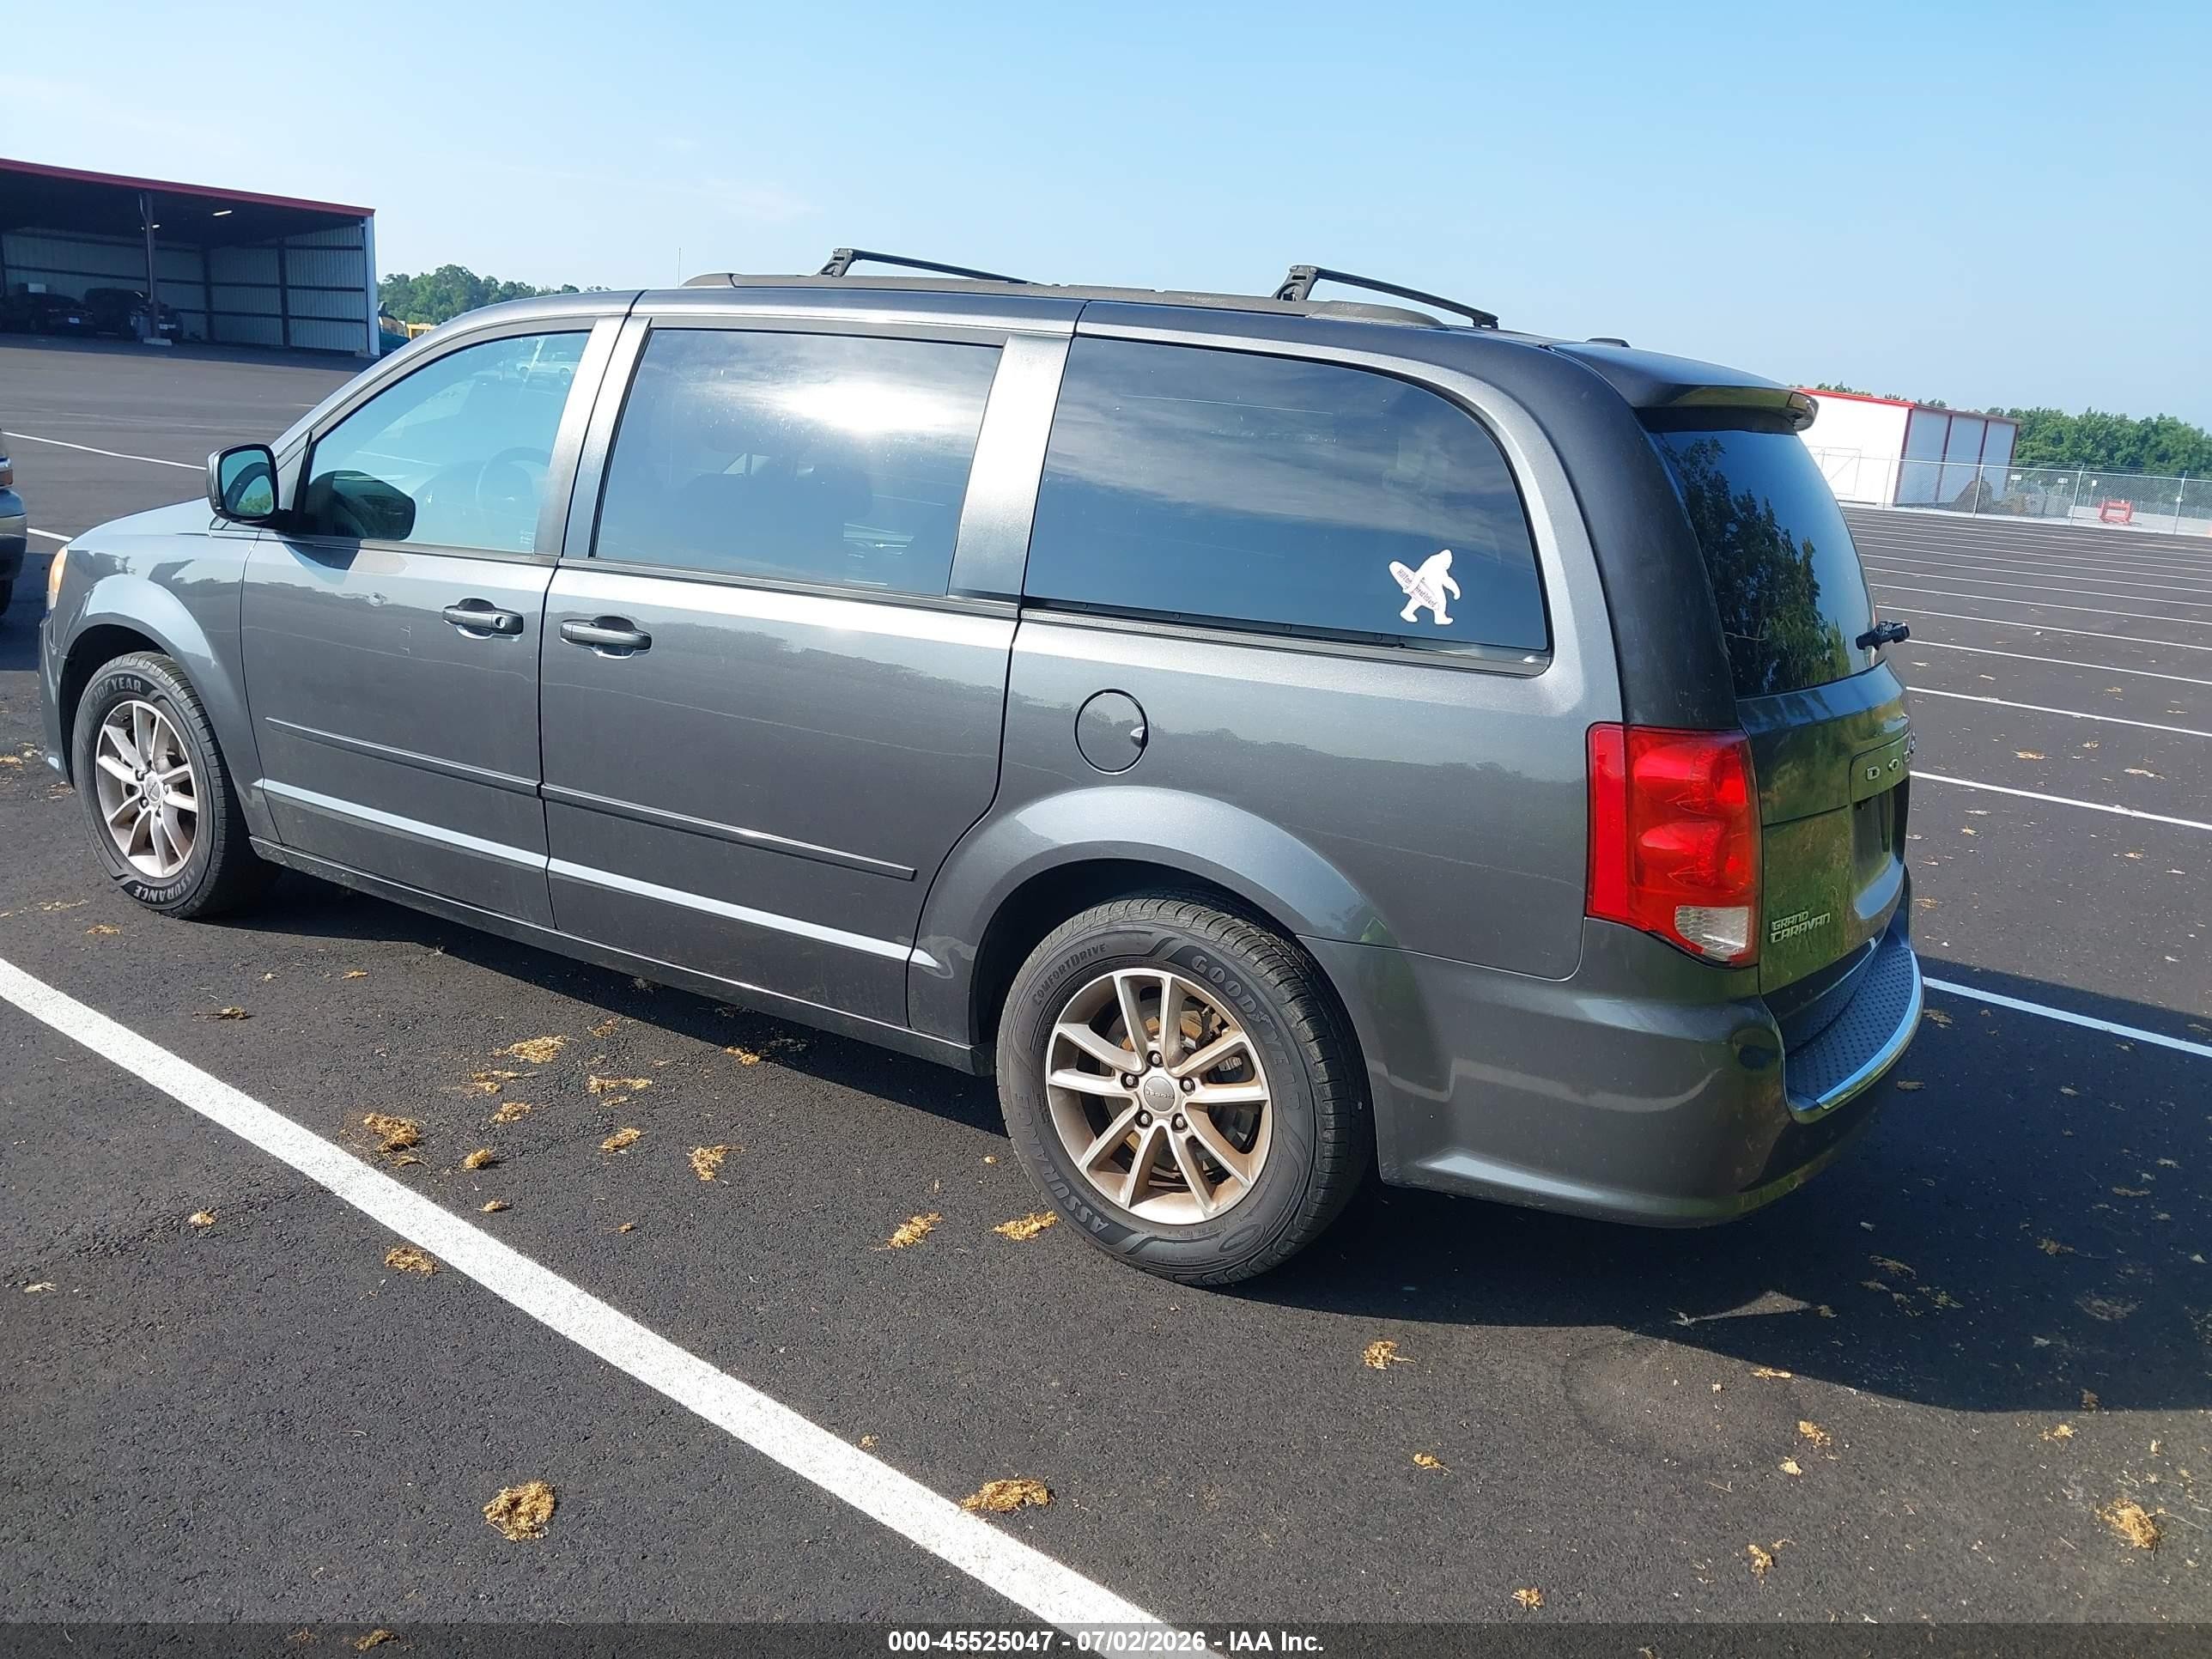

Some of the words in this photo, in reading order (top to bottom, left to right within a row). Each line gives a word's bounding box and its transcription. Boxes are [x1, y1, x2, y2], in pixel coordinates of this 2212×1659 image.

[1771, 911, 1809, 932] GRAND
[1771, 912, 1831, 944] CARAVAN
[1190, 955, 1302, 1111] GOODYEAR
[1015, 1091, 1109, 1234] ASSURANCE
